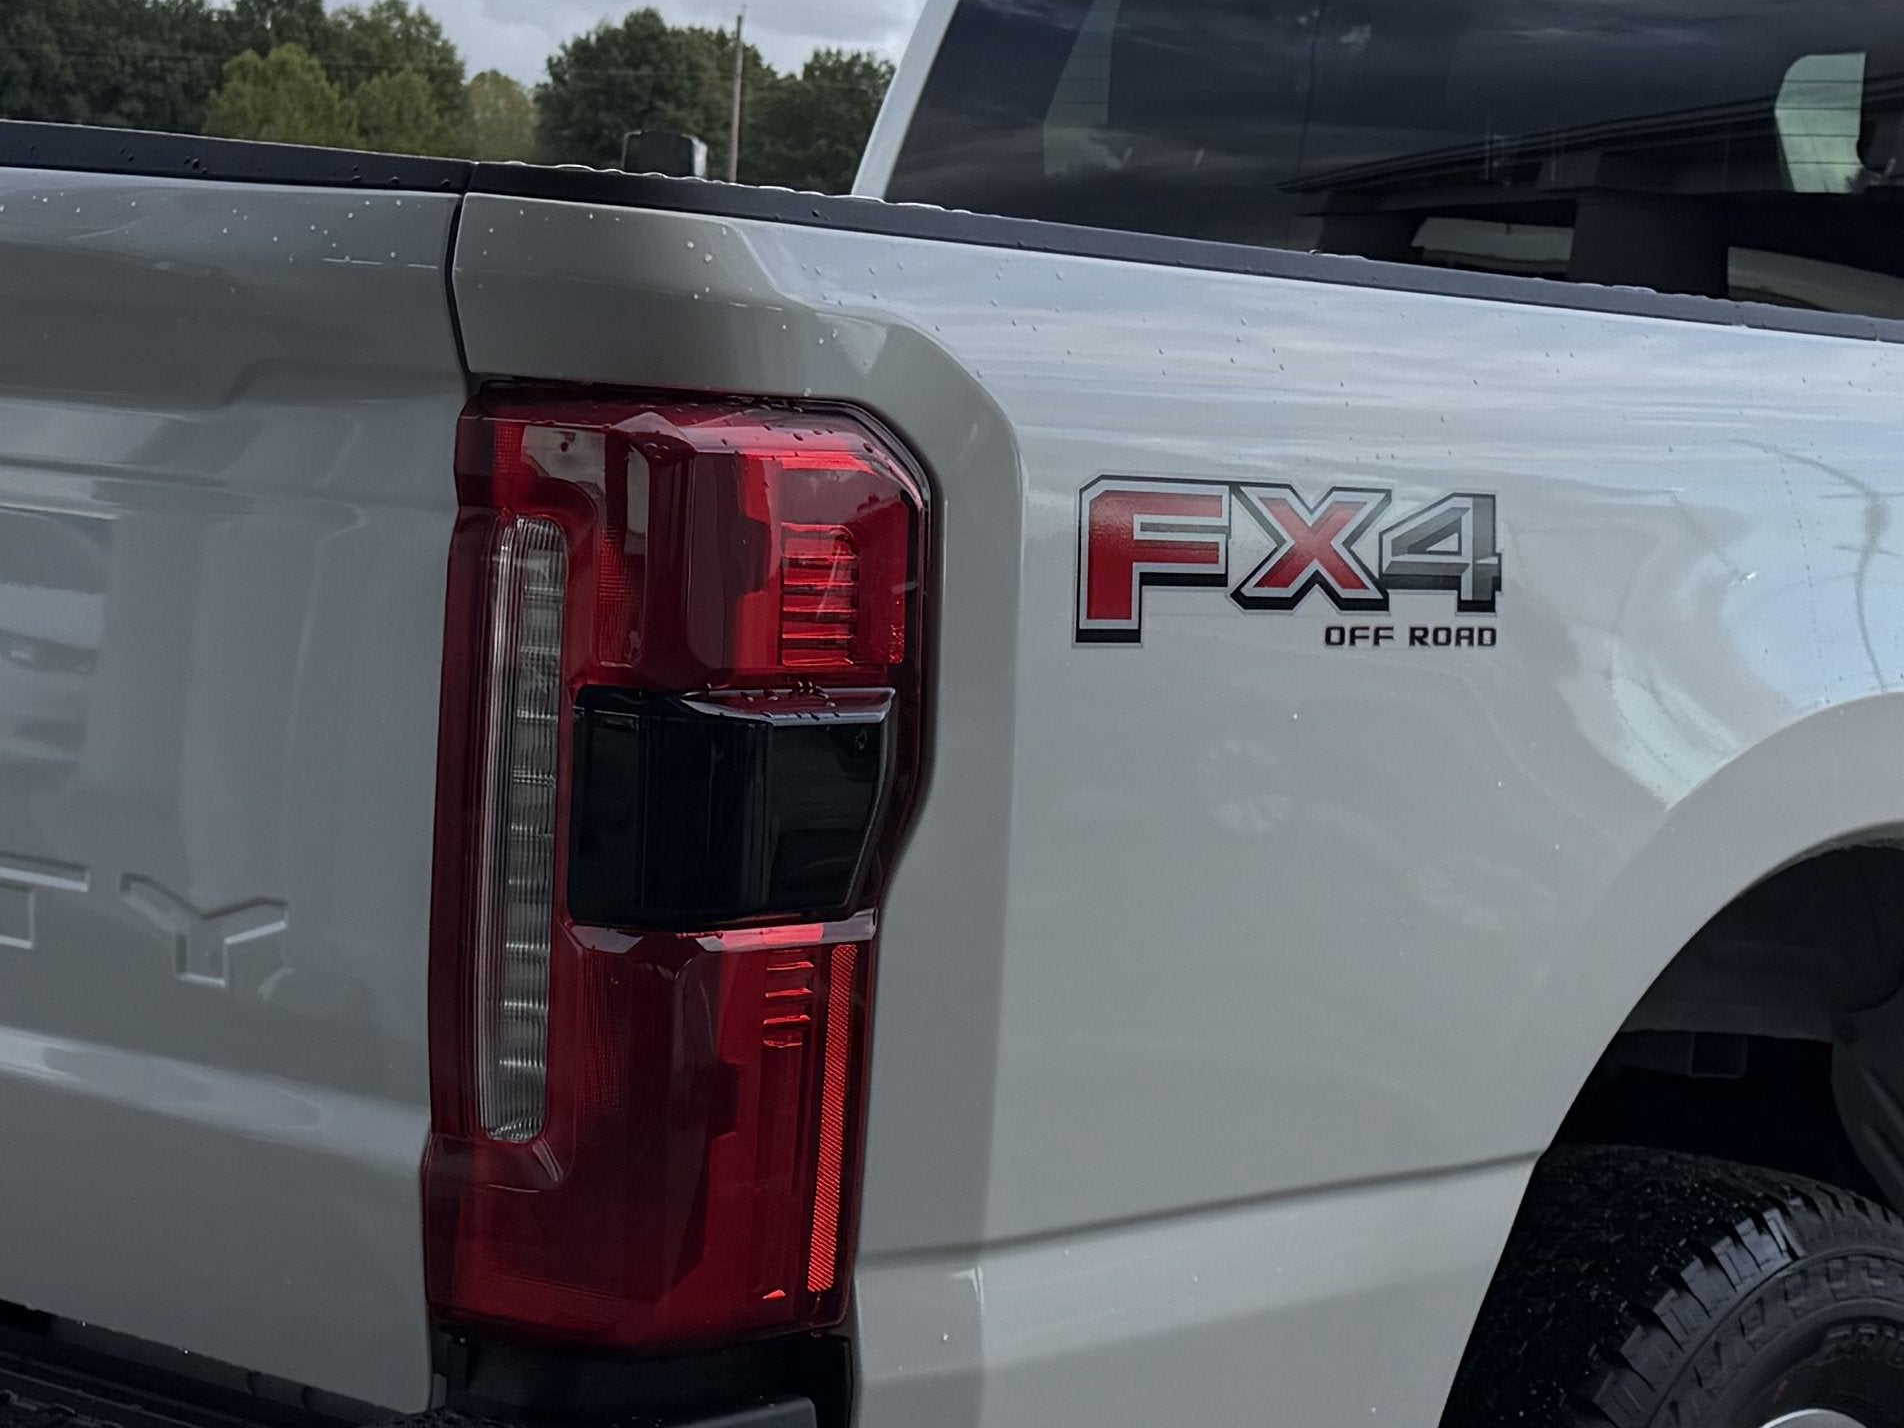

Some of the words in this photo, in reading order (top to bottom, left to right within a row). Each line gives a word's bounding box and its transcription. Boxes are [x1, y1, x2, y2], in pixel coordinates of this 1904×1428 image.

[1073, 472, 1503, 646] FX4
[1324, 625, 1395, 647] OFF
[1408, 626, 1498, 648] ROAD
